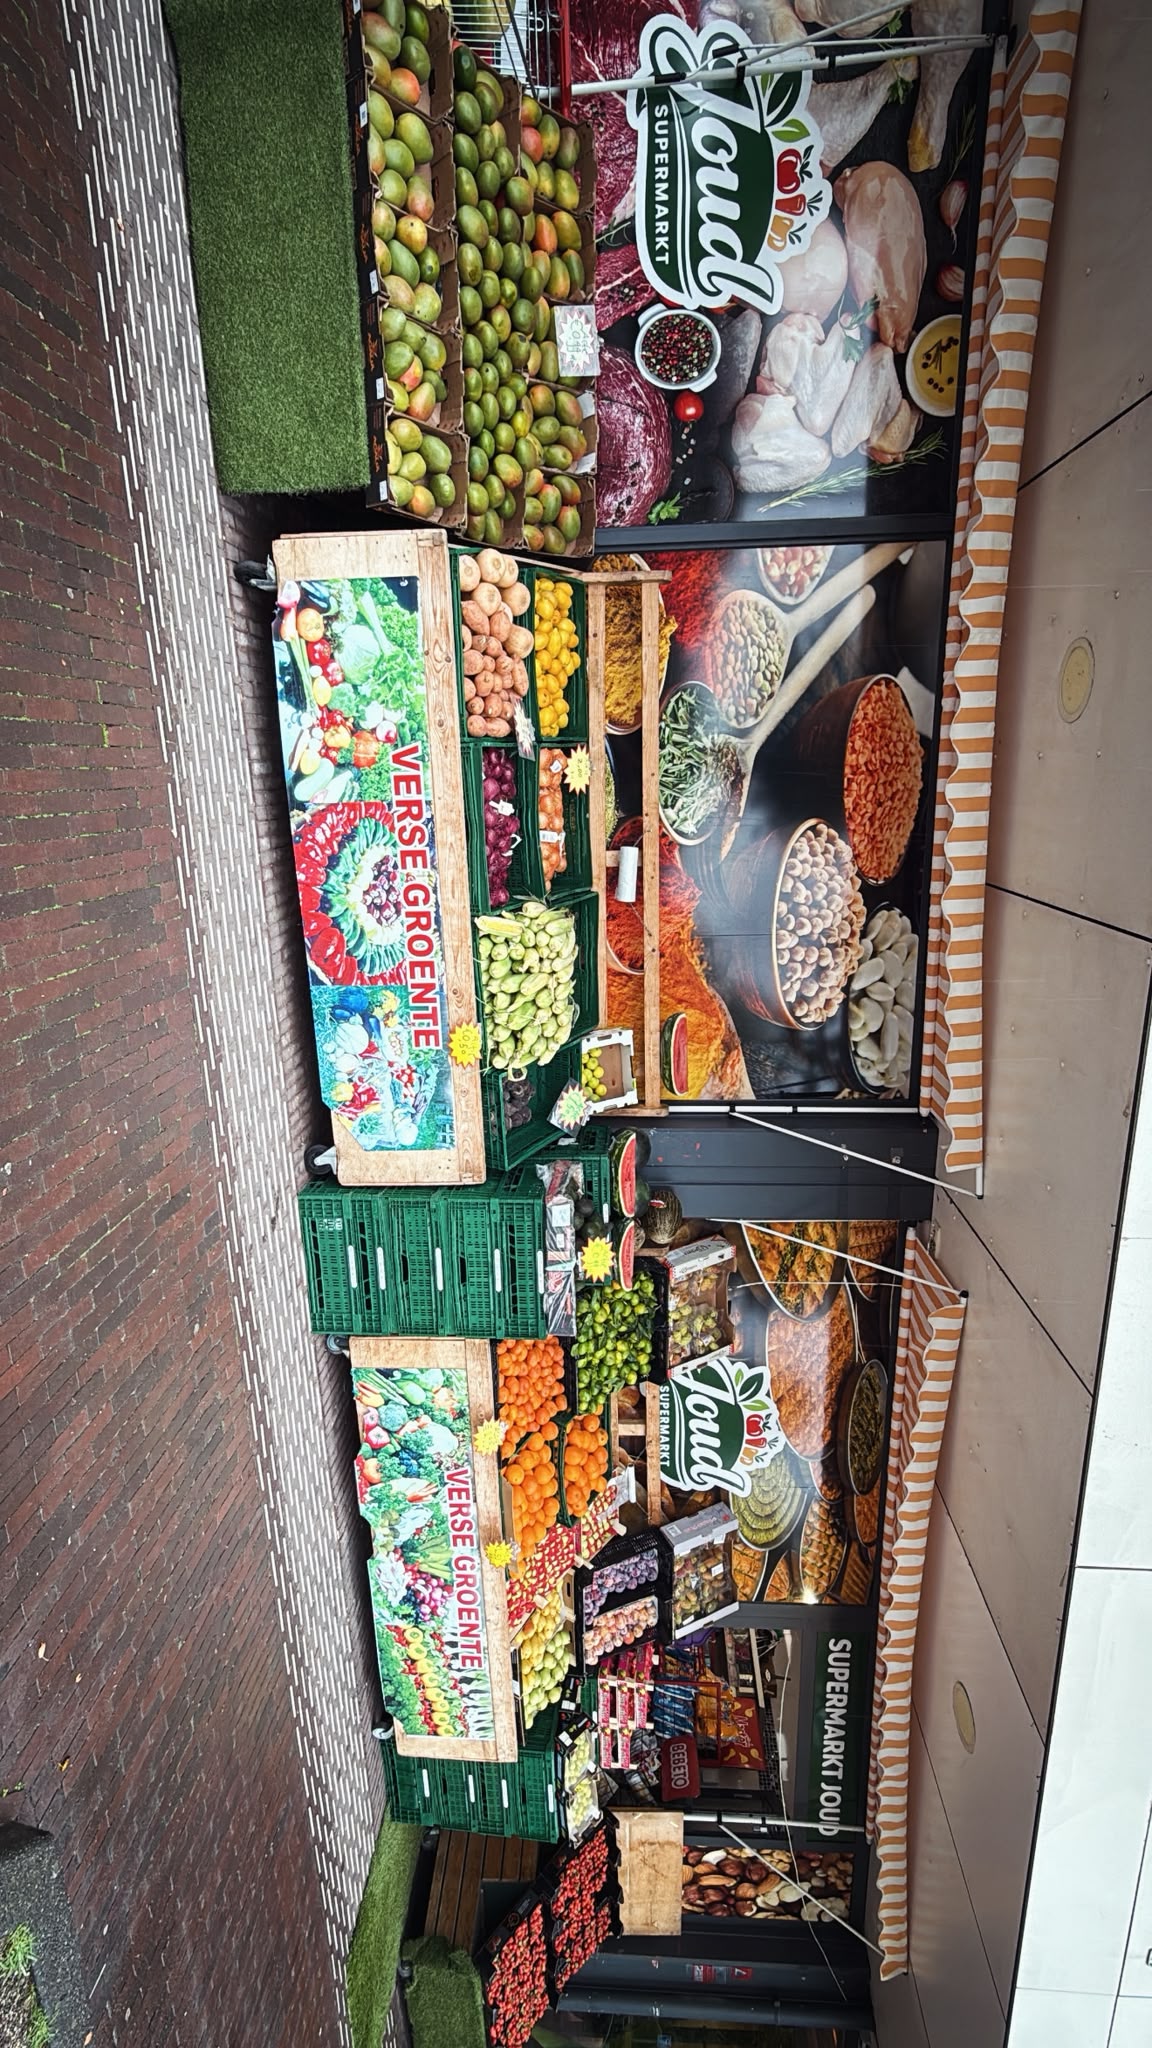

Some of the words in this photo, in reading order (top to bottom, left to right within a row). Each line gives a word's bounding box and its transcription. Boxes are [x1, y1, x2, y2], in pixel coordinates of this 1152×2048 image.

[654, 25, 776, 304] Joud
[654, 104, 670, 265] SUPERMARKT
[391, 745, 429, 870] VERSE
[403, 882, 440, 1048] GROENTE
[660, 1385, 670, 1467] SUPERMARKT
[671, 1358, 746, 1491] Joud
[446, 1469, 474, 1547] VERSE
[453, 1555, 483, 1668] GROENTE
[670, 1743, 689, 1789] BEBETO
[821, 1638, 852, 1780] SUPERMARKT
[817, 1782, 843, 1837] JOUD
